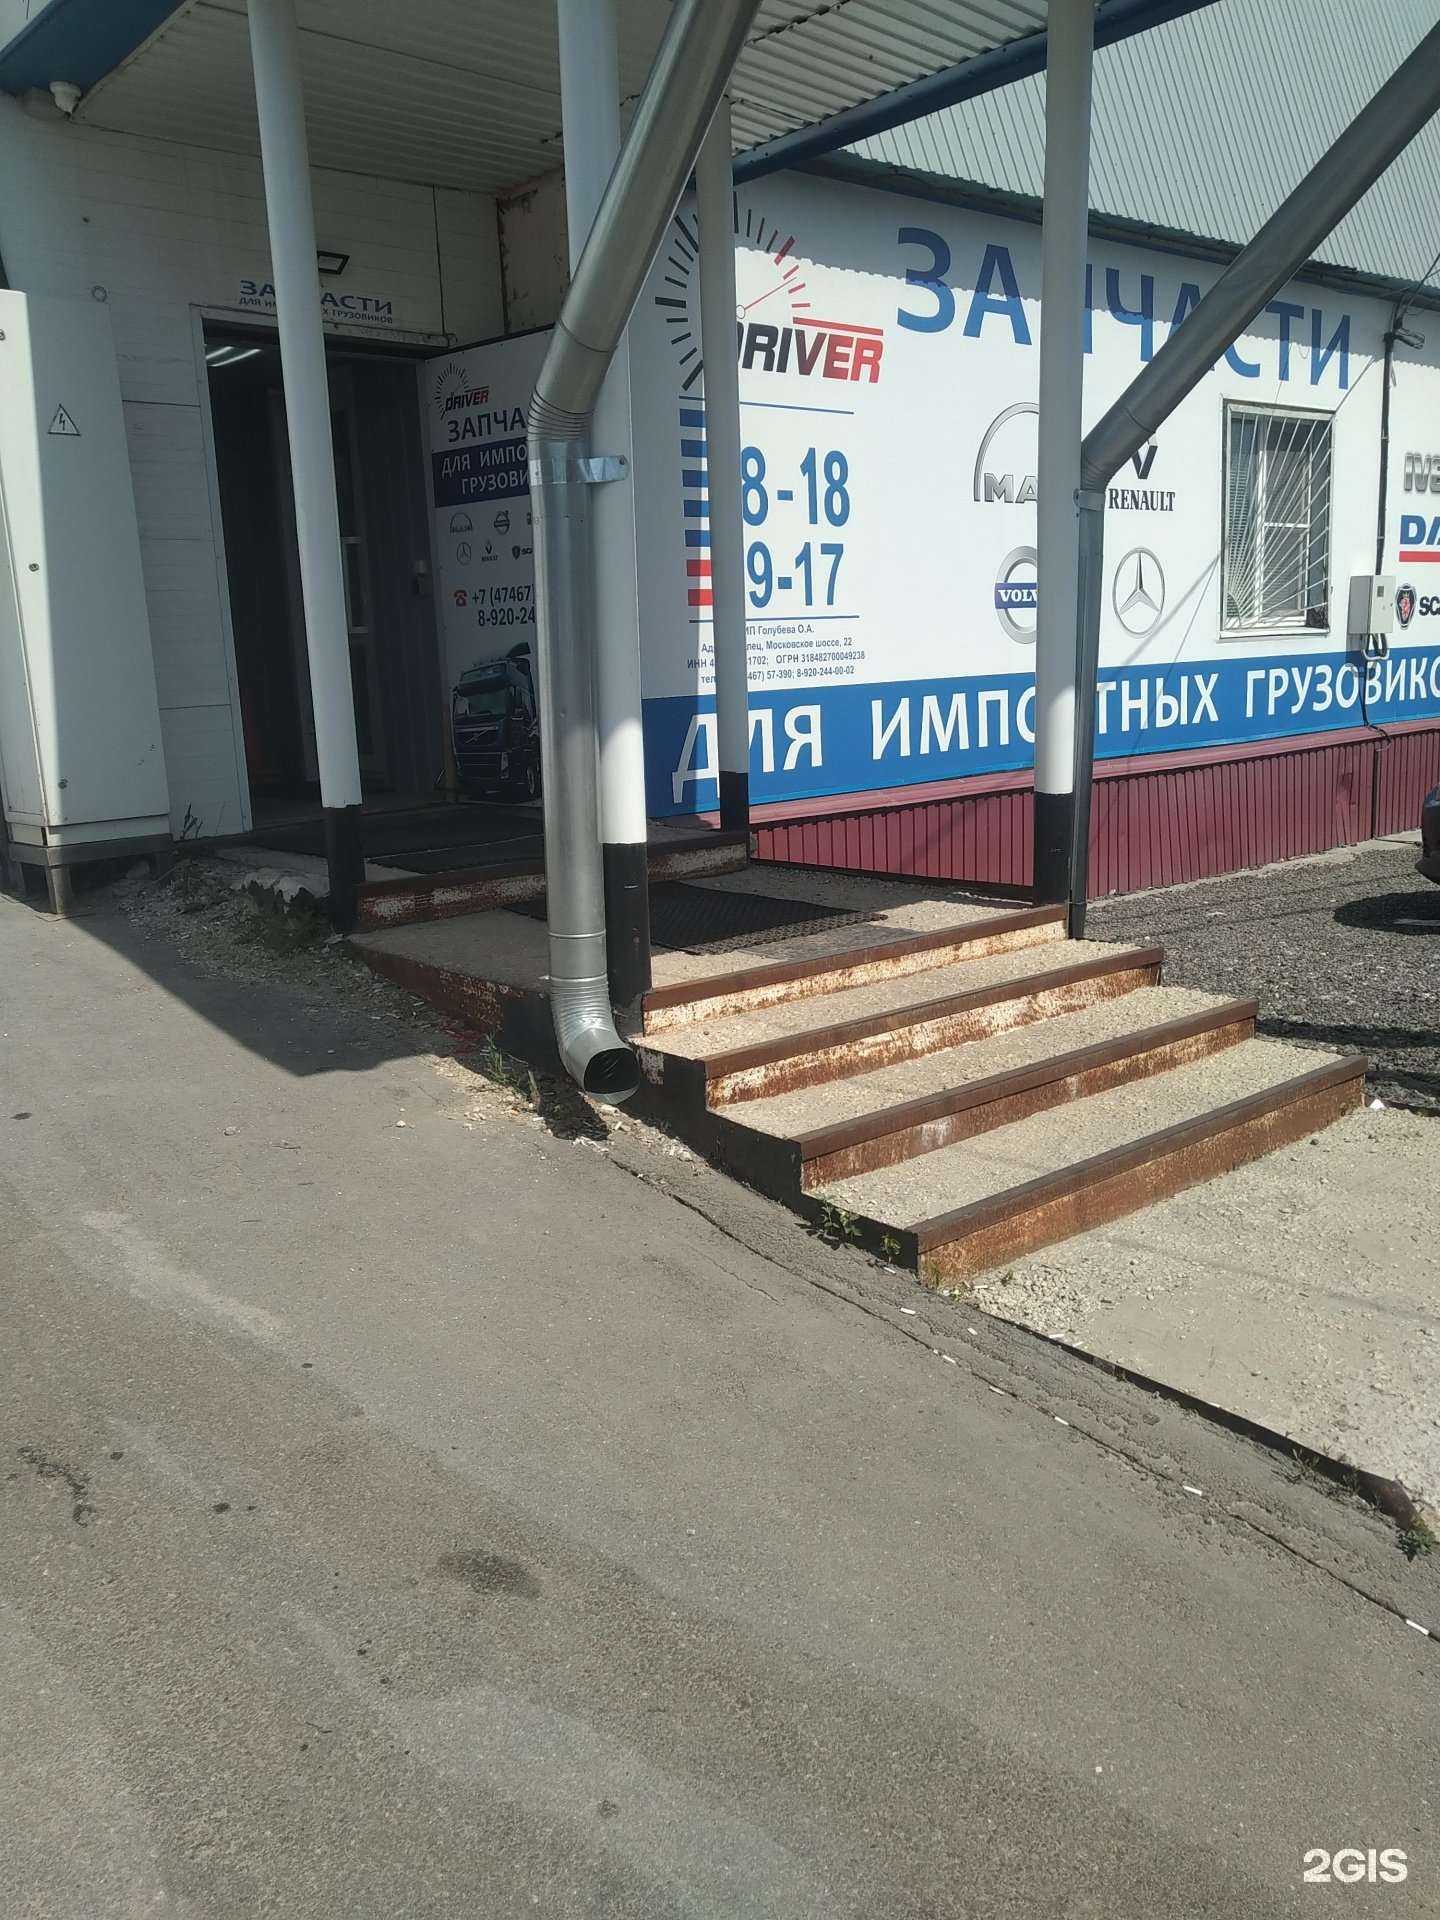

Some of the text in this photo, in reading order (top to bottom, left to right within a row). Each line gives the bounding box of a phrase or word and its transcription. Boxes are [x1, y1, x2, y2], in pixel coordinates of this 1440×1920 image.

[445, 389, 489, 412] DRIVER
[441, 454, 471, 479] ДЛЯ
[1108, 488, 1176, 512] RENAULT
[746, 541, 844, 608] 9-17
[472, 588, 486, 605] +7
[758, 624, 796, 637] Голубева
[766, 638, 814, 650] Московское
[815, 638, 842, 648] шоссе,
[844, 637, 853, 646] 22
[687, 658, 707, 669] ИНН
[776, 653, 799, 664] ОГРН
[796, 665, 855, 678] 8-920-244-00-02
